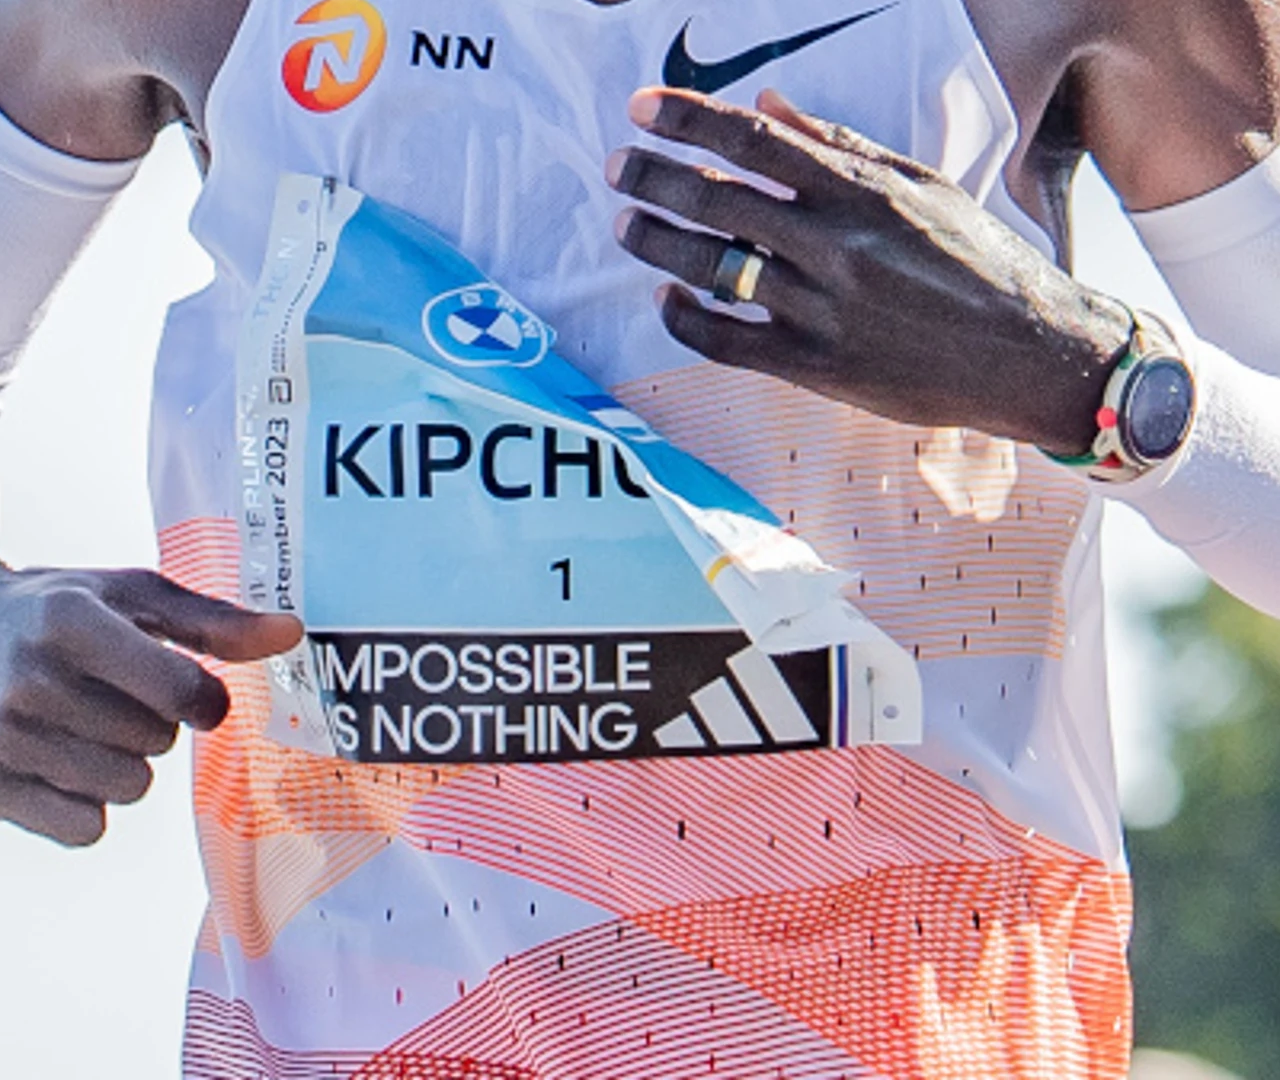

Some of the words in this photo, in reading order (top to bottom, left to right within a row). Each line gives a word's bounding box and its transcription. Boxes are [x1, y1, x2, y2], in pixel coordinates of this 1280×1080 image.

[410, 29, 495, 69] NN
[265, 417, 289, 487] 2023
[549, 557, 571, 601] 1
[316, 642, 652, 694] IMPOSSIBLE
[326, 702, 359, 752] S
[371, 701, 639, 755] NOTHING
